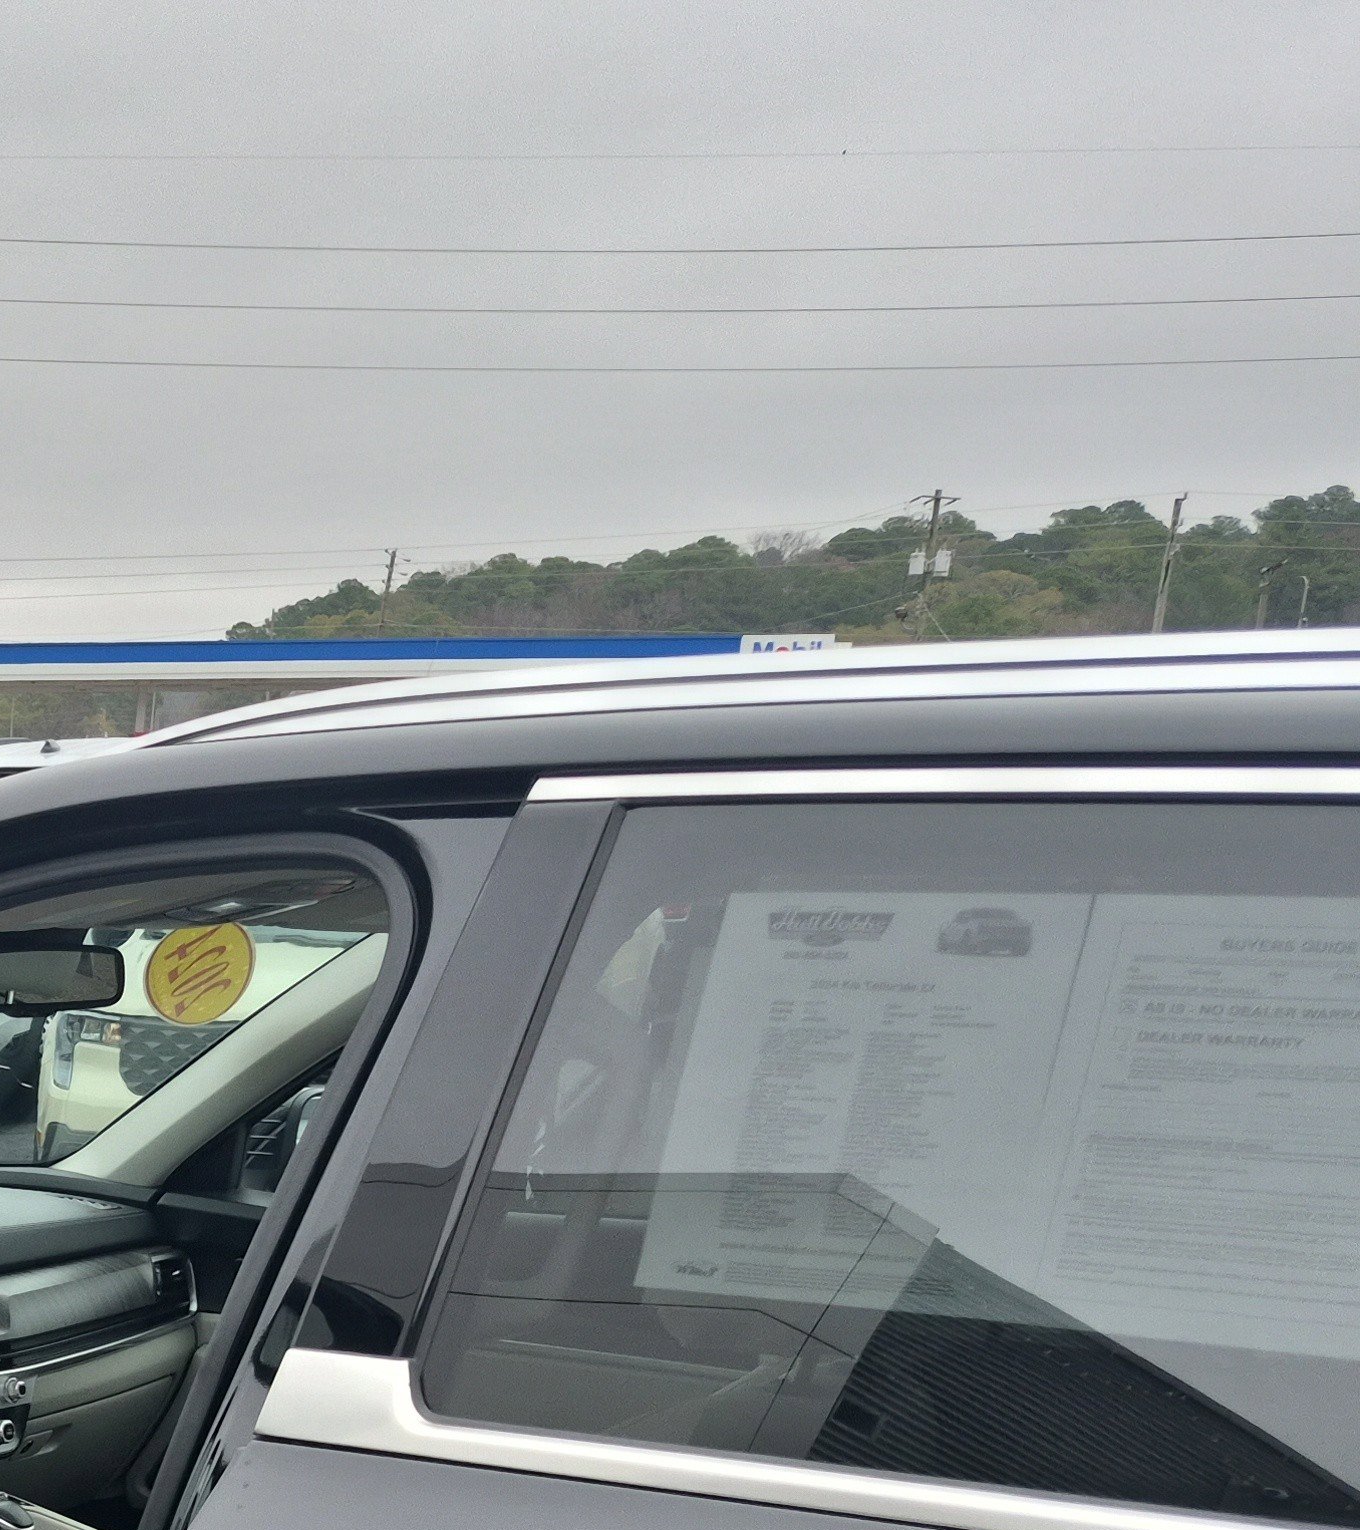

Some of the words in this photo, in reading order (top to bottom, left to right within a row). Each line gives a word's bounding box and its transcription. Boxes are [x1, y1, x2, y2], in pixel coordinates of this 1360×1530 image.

[1220, 938, 1295, 952] BUYERS
[1301, 940, 1358, 954] GUIDE
[1199, 1004, 1225, 1016] NO
[1228, 1005, 1297, 1019] DEALER
[1137, 1030, 1203, 1043] DEALER
[1207, 1033, 1305, 1048] WARRANTY
